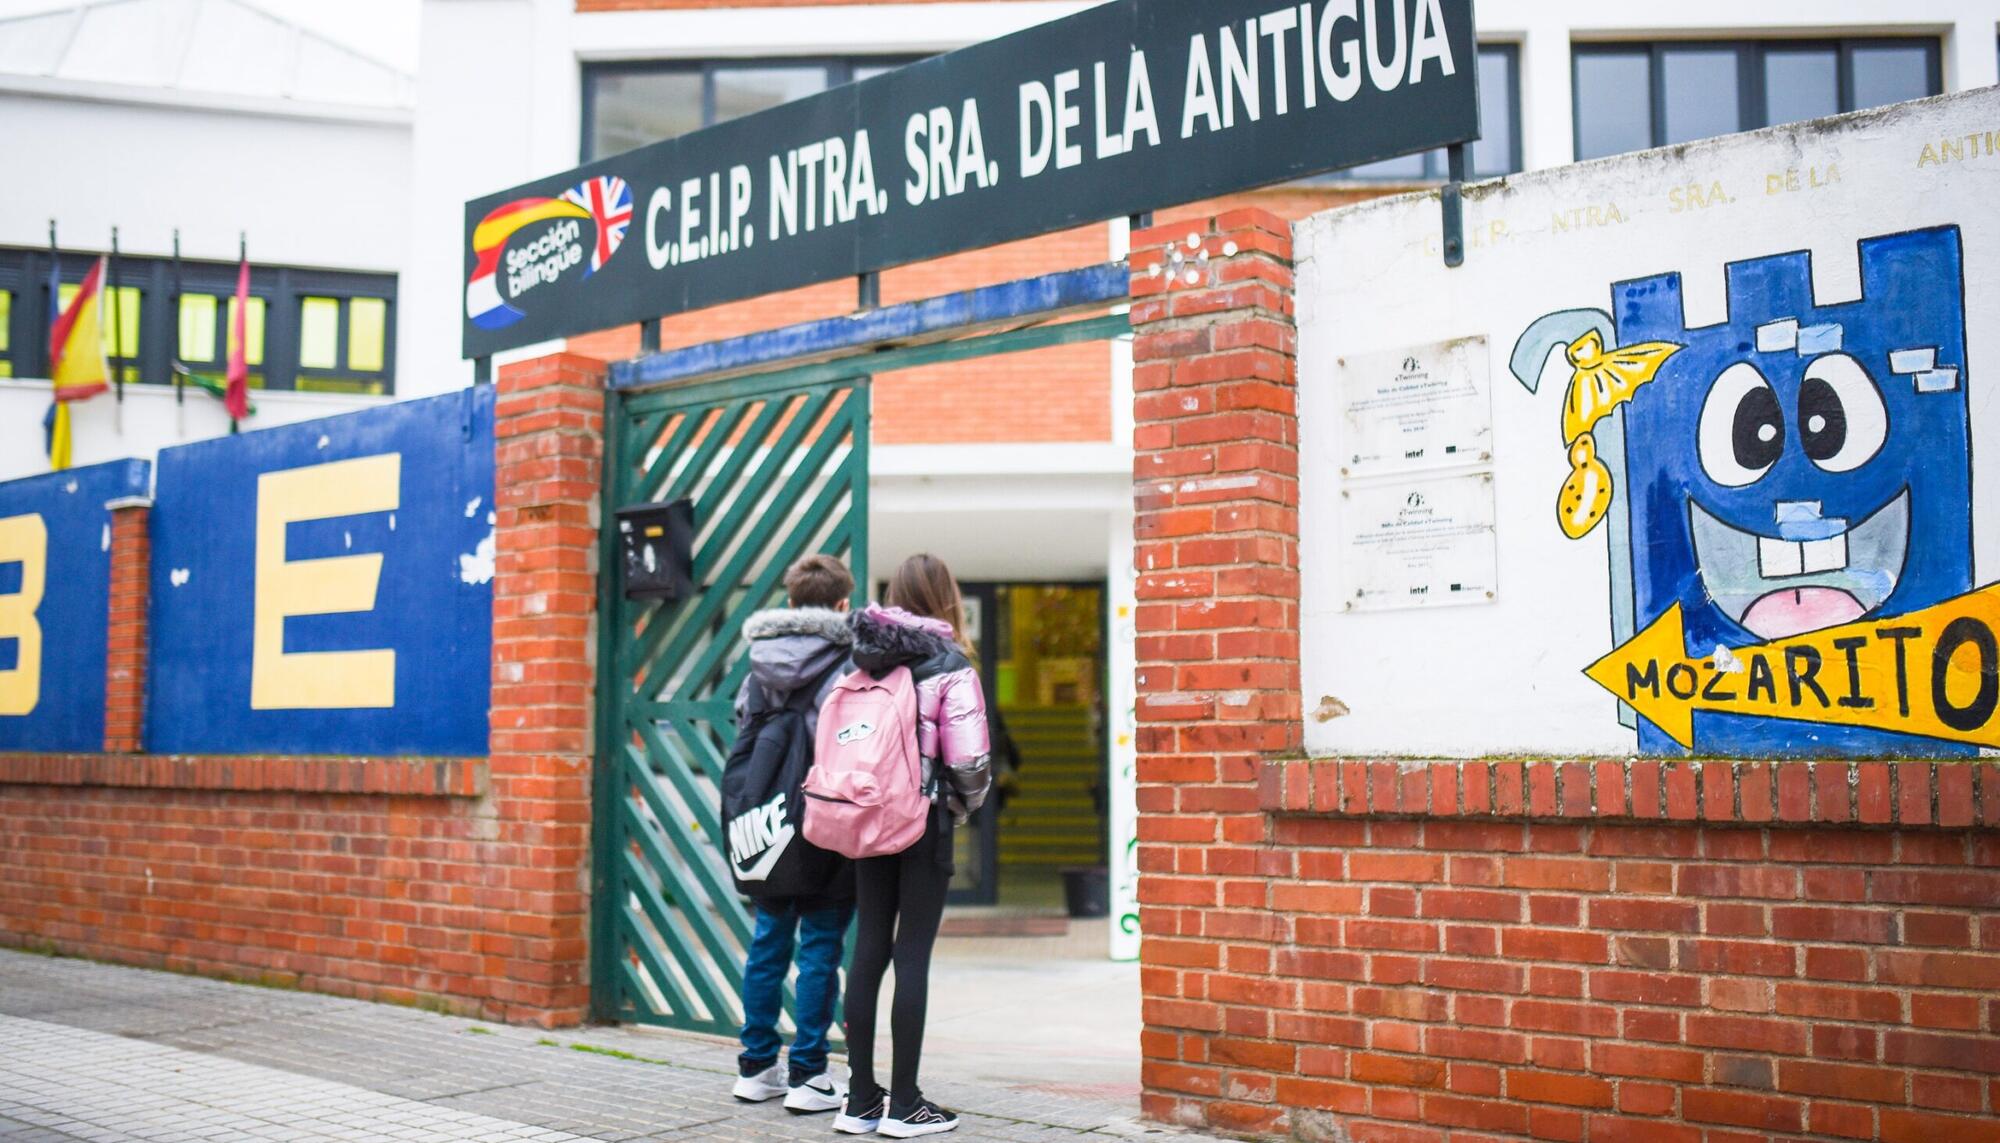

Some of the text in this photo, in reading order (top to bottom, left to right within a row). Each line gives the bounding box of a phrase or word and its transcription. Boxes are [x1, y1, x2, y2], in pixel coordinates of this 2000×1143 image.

[645, 0, 1456, 270] C.E.I.P. NTRA. SRA. DE LA ANTIGUA
[1668, 180, 1736, 214] SRA.
[506, 217, 580, 274] Sección
[508, 240, 583, 299] bilingüe
[1405, 448, 1424, 459] intef
[1410, 585, 1429, 595] intef
[1625, 616, 2000, 732] MOZARITO
[729, 792, 788, 864] NIKE
